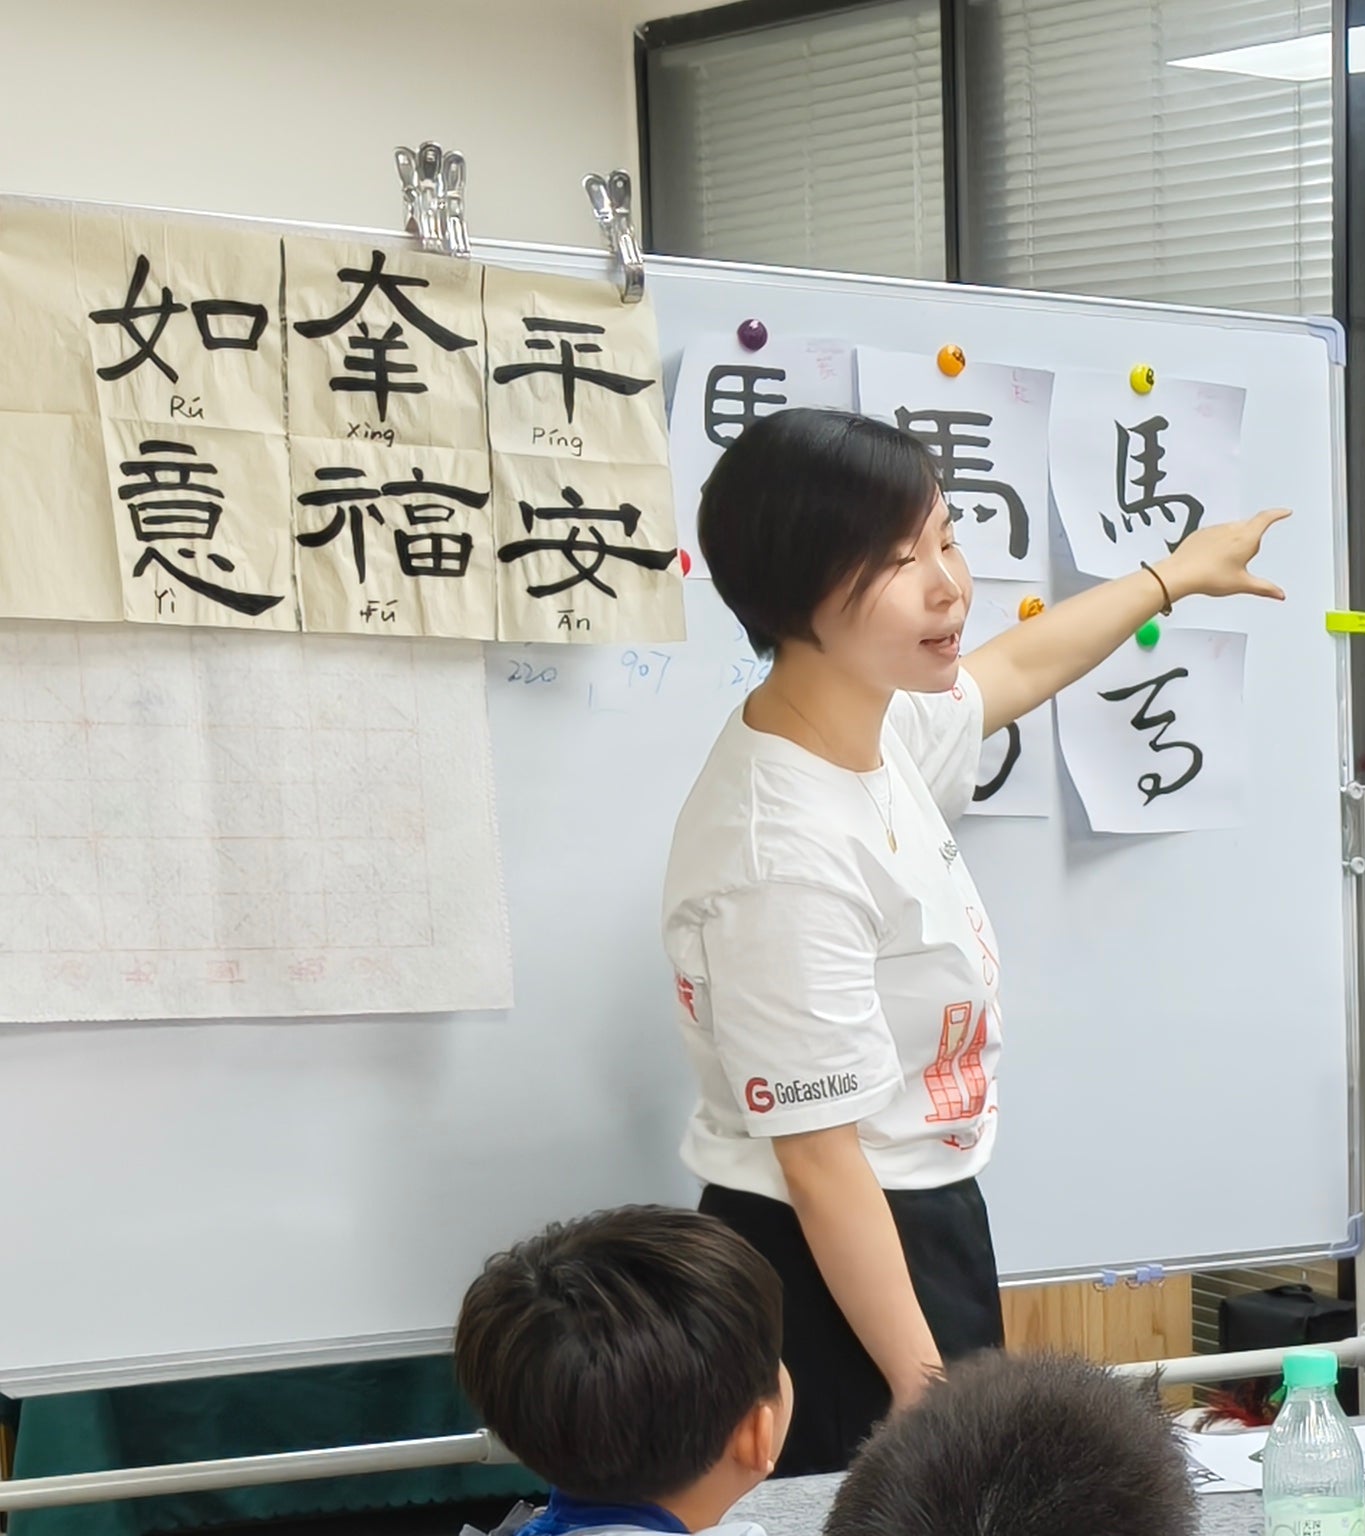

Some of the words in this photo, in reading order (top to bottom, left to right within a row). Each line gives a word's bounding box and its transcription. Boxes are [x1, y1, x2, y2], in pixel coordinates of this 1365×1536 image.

[88, 254, 268, 384] 如
[492, 317, 656, 424] 平
[169, 394, 205, 420] Rú
[117, 440, 286, 618] 意
[296, 466, 491, 584] 福
[497, 485, 679, 600] 安
[774, 1078, 829, 1105] GoEast
